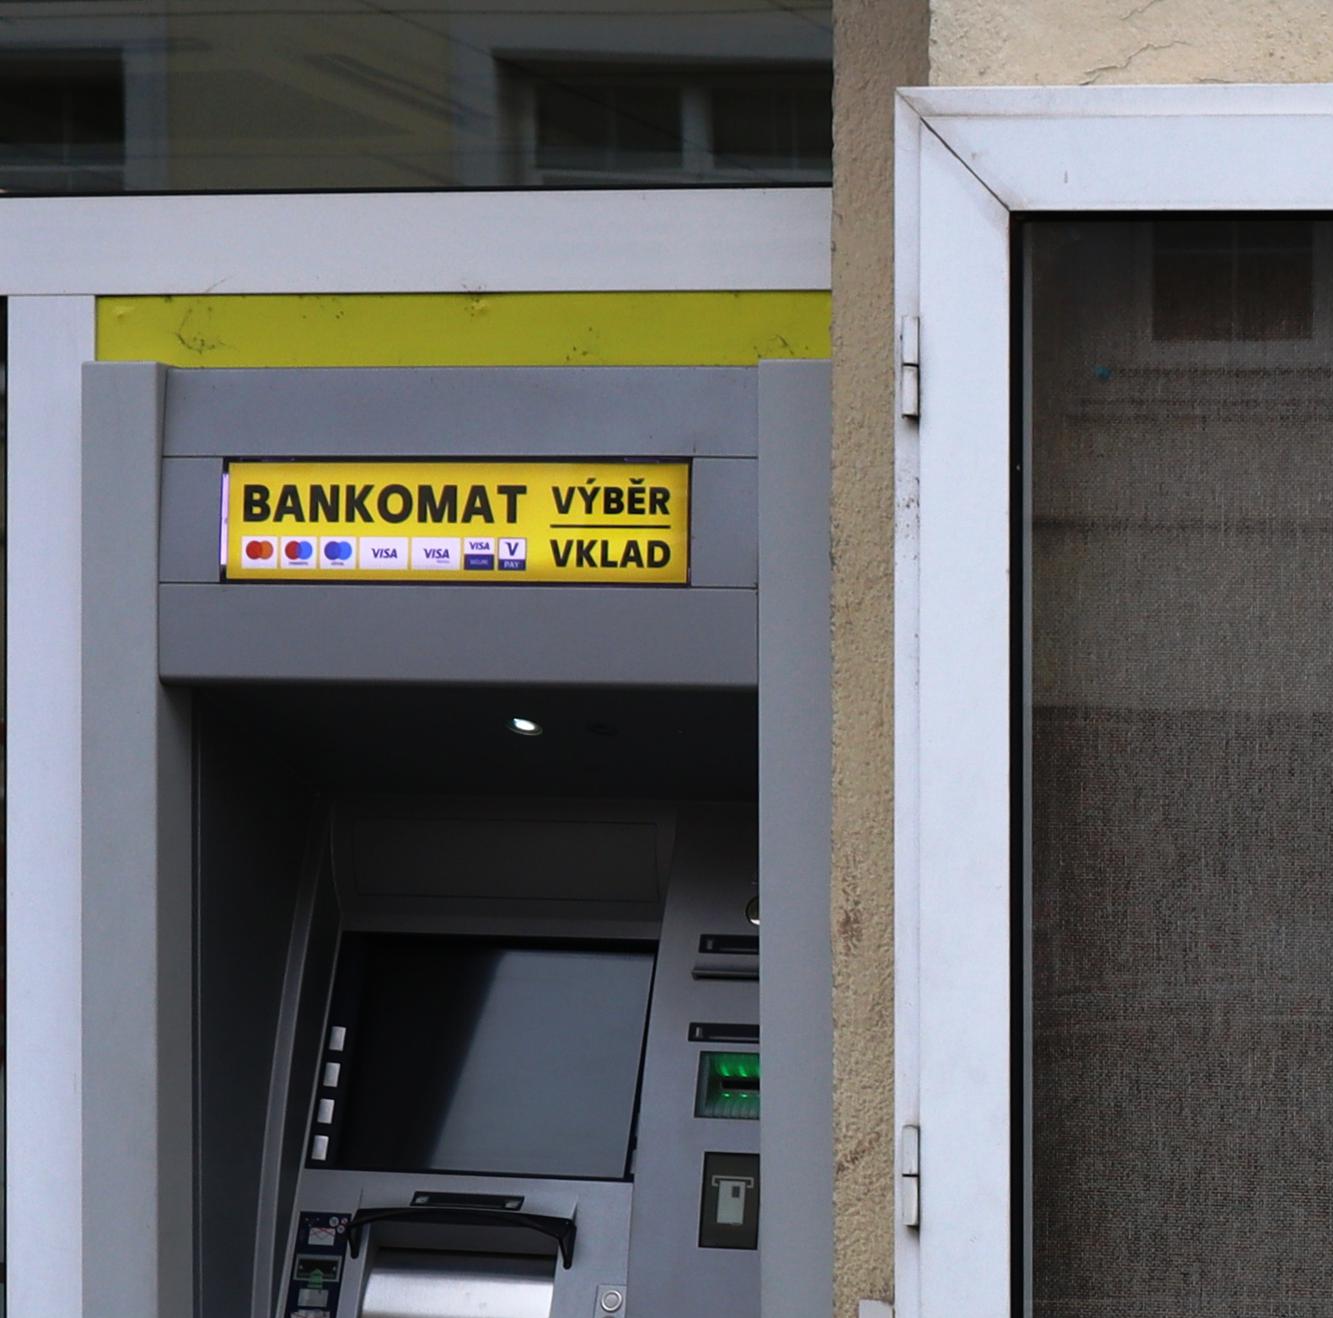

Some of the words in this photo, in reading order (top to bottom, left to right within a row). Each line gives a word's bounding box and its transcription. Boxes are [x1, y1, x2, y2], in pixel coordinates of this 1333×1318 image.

[242, 483, 528, 524] BANKOMAT
[551, 478, 672, 515] VÝBĚR
[371, 547, 398, 560] VISA
[423, 547, 450, 560] VISA
[469, 541, 491, 551] VISA
[549, 539, 672, 570] VKLAD
